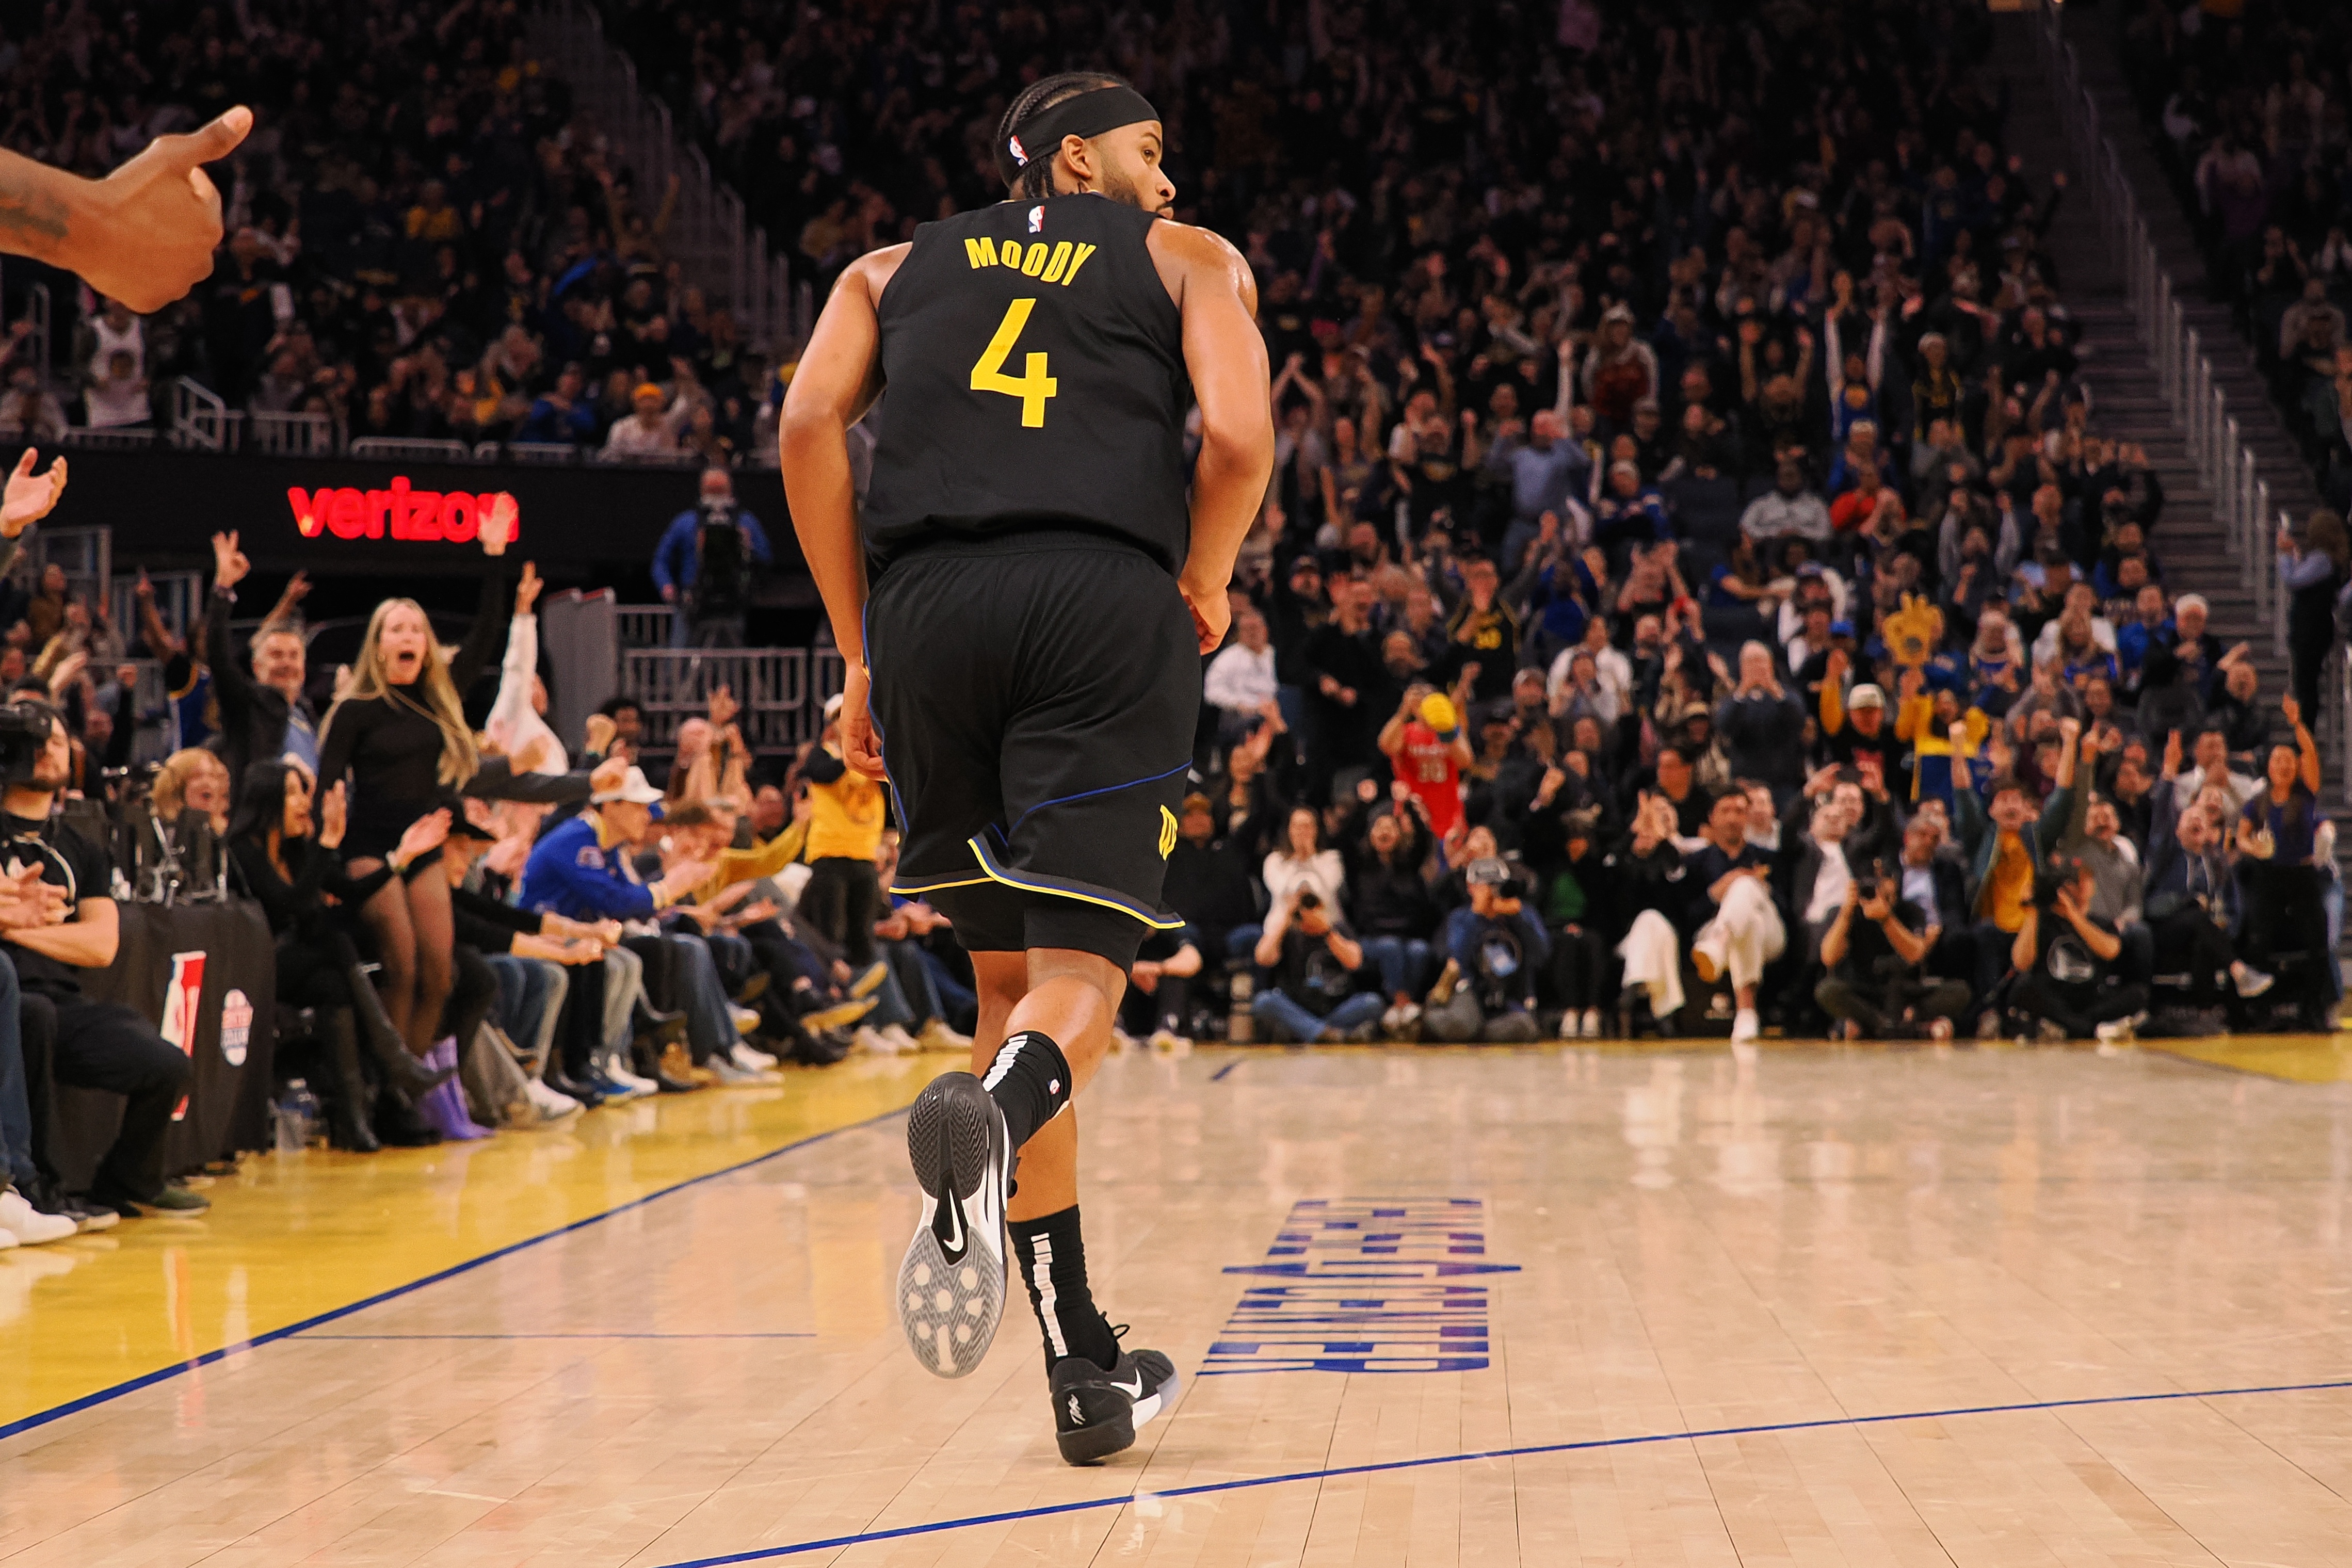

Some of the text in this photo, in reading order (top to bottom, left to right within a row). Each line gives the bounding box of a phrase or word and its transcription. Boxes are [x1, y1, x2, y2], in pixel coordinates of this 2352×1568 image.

[964, 236, 1097, 286] MOODY
[970, 298, 1057, 428] 4
[1196, 1284, 1490, 1377] CENTER
